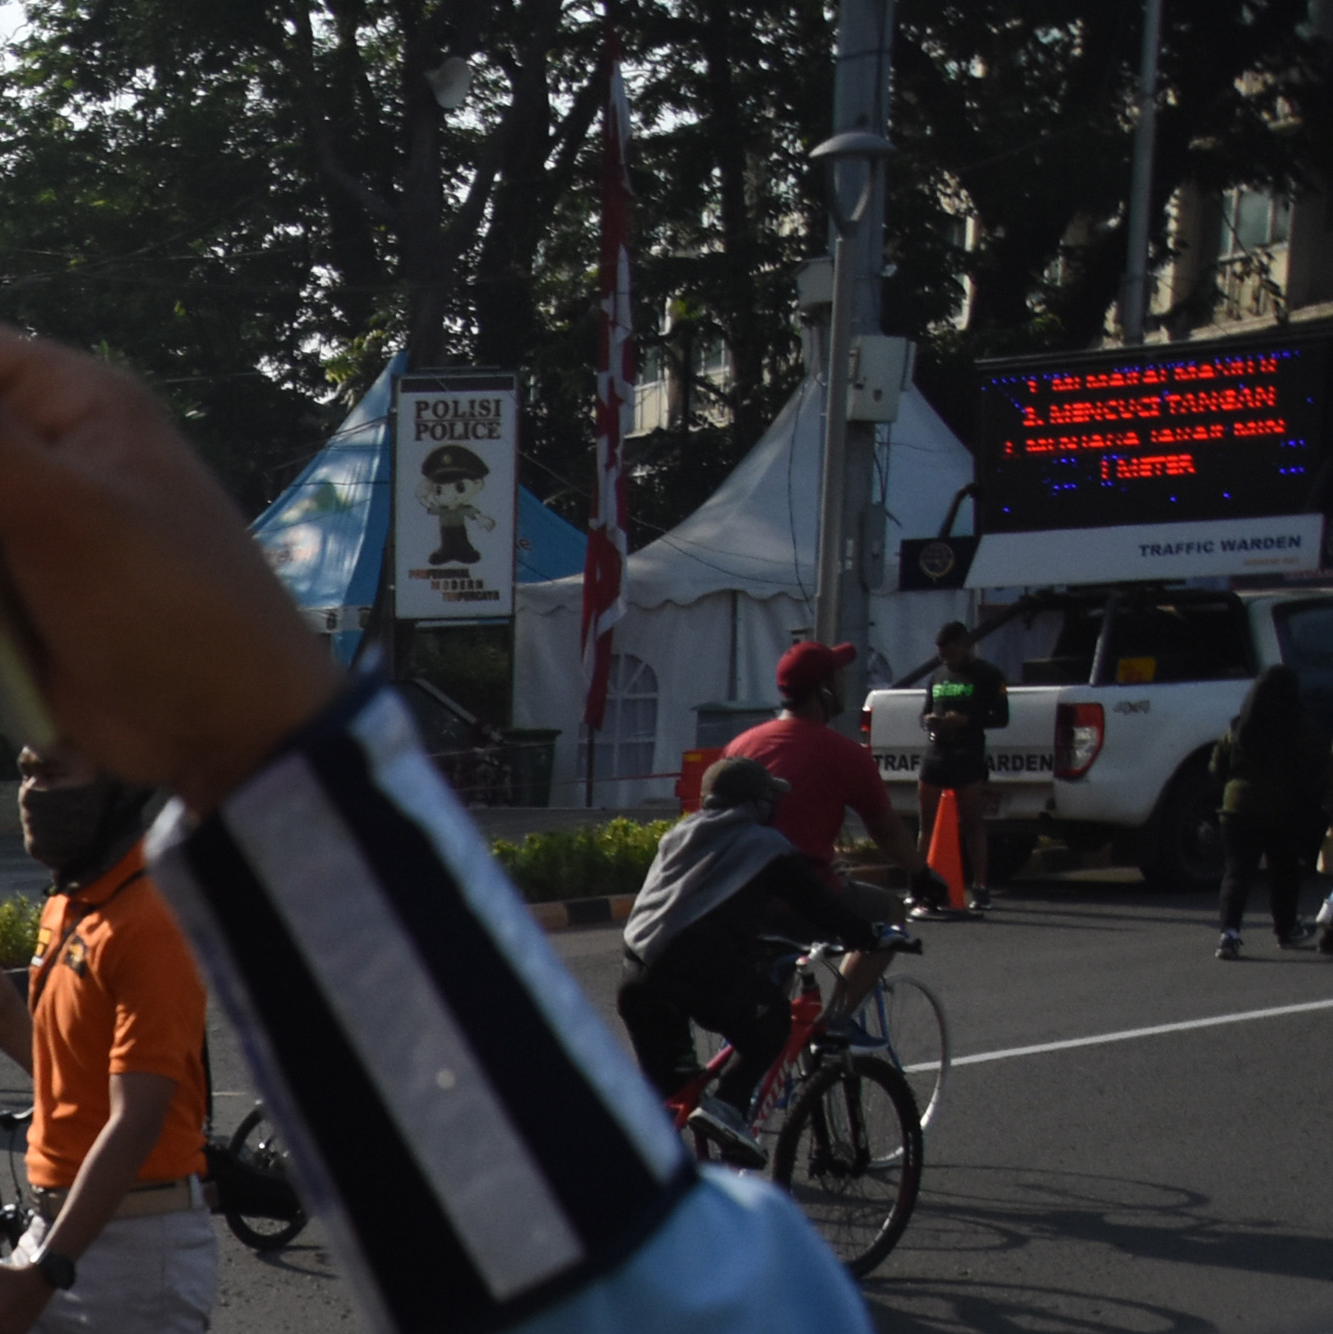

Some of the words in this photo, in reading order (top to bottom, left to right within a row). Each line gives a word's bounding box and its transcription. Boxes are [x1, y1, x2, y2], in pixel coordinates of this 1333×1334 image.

[414, 398, 502, 420] POLISI
[414, 421, 502, 441] POLICE
[1139, 541, 1215, 558] TRAFFIC
[1221, 535, 1302, 552] WARDEN
[874, 753, 921, 771] TRAF
[986, 753, 1054, 771] ARDEN
